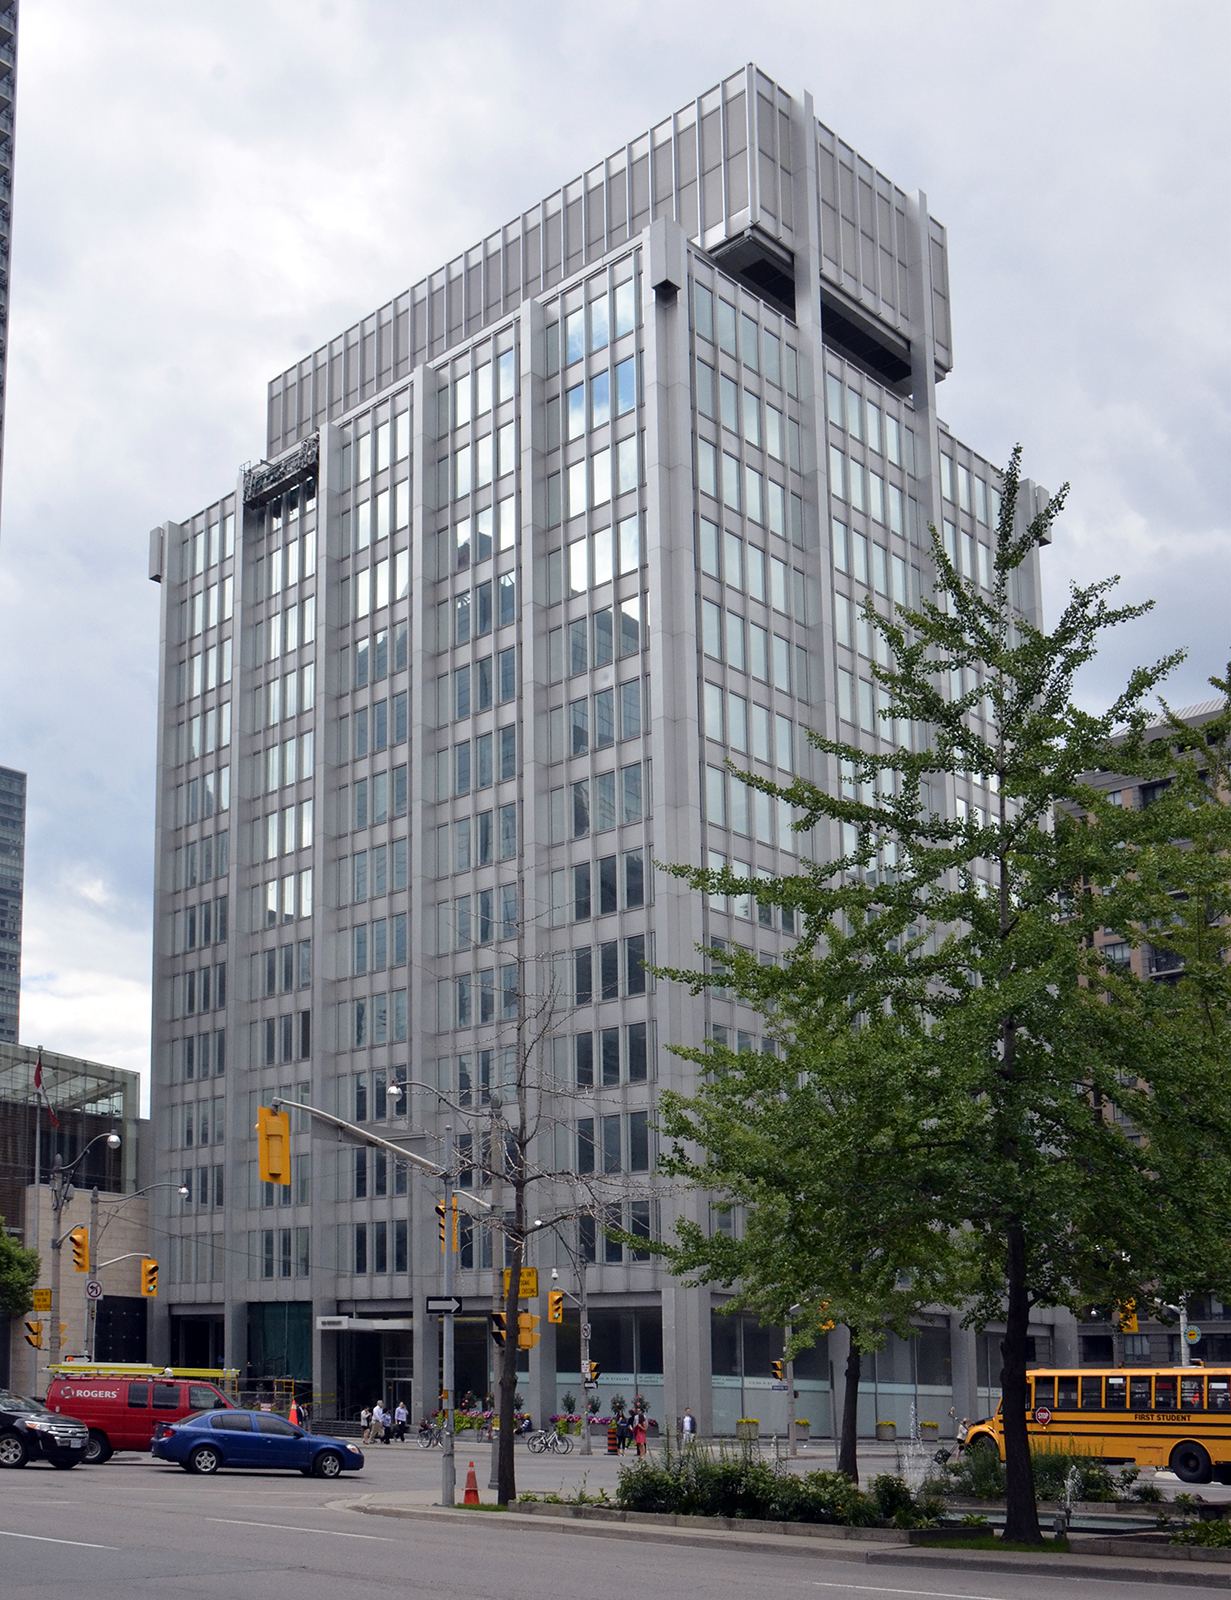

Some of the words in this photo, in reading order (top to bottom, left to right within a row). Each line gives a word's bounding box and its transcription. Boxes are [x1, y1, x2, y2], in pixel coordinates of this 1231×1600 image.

[76, 1389, 117, 1399] ROGERS
[1037, 1412, 1049, 1420] STOP
[1134, 1413, 1155, 1421] FIRST
[1156, 1414, 1192, 1422] STUDENT
